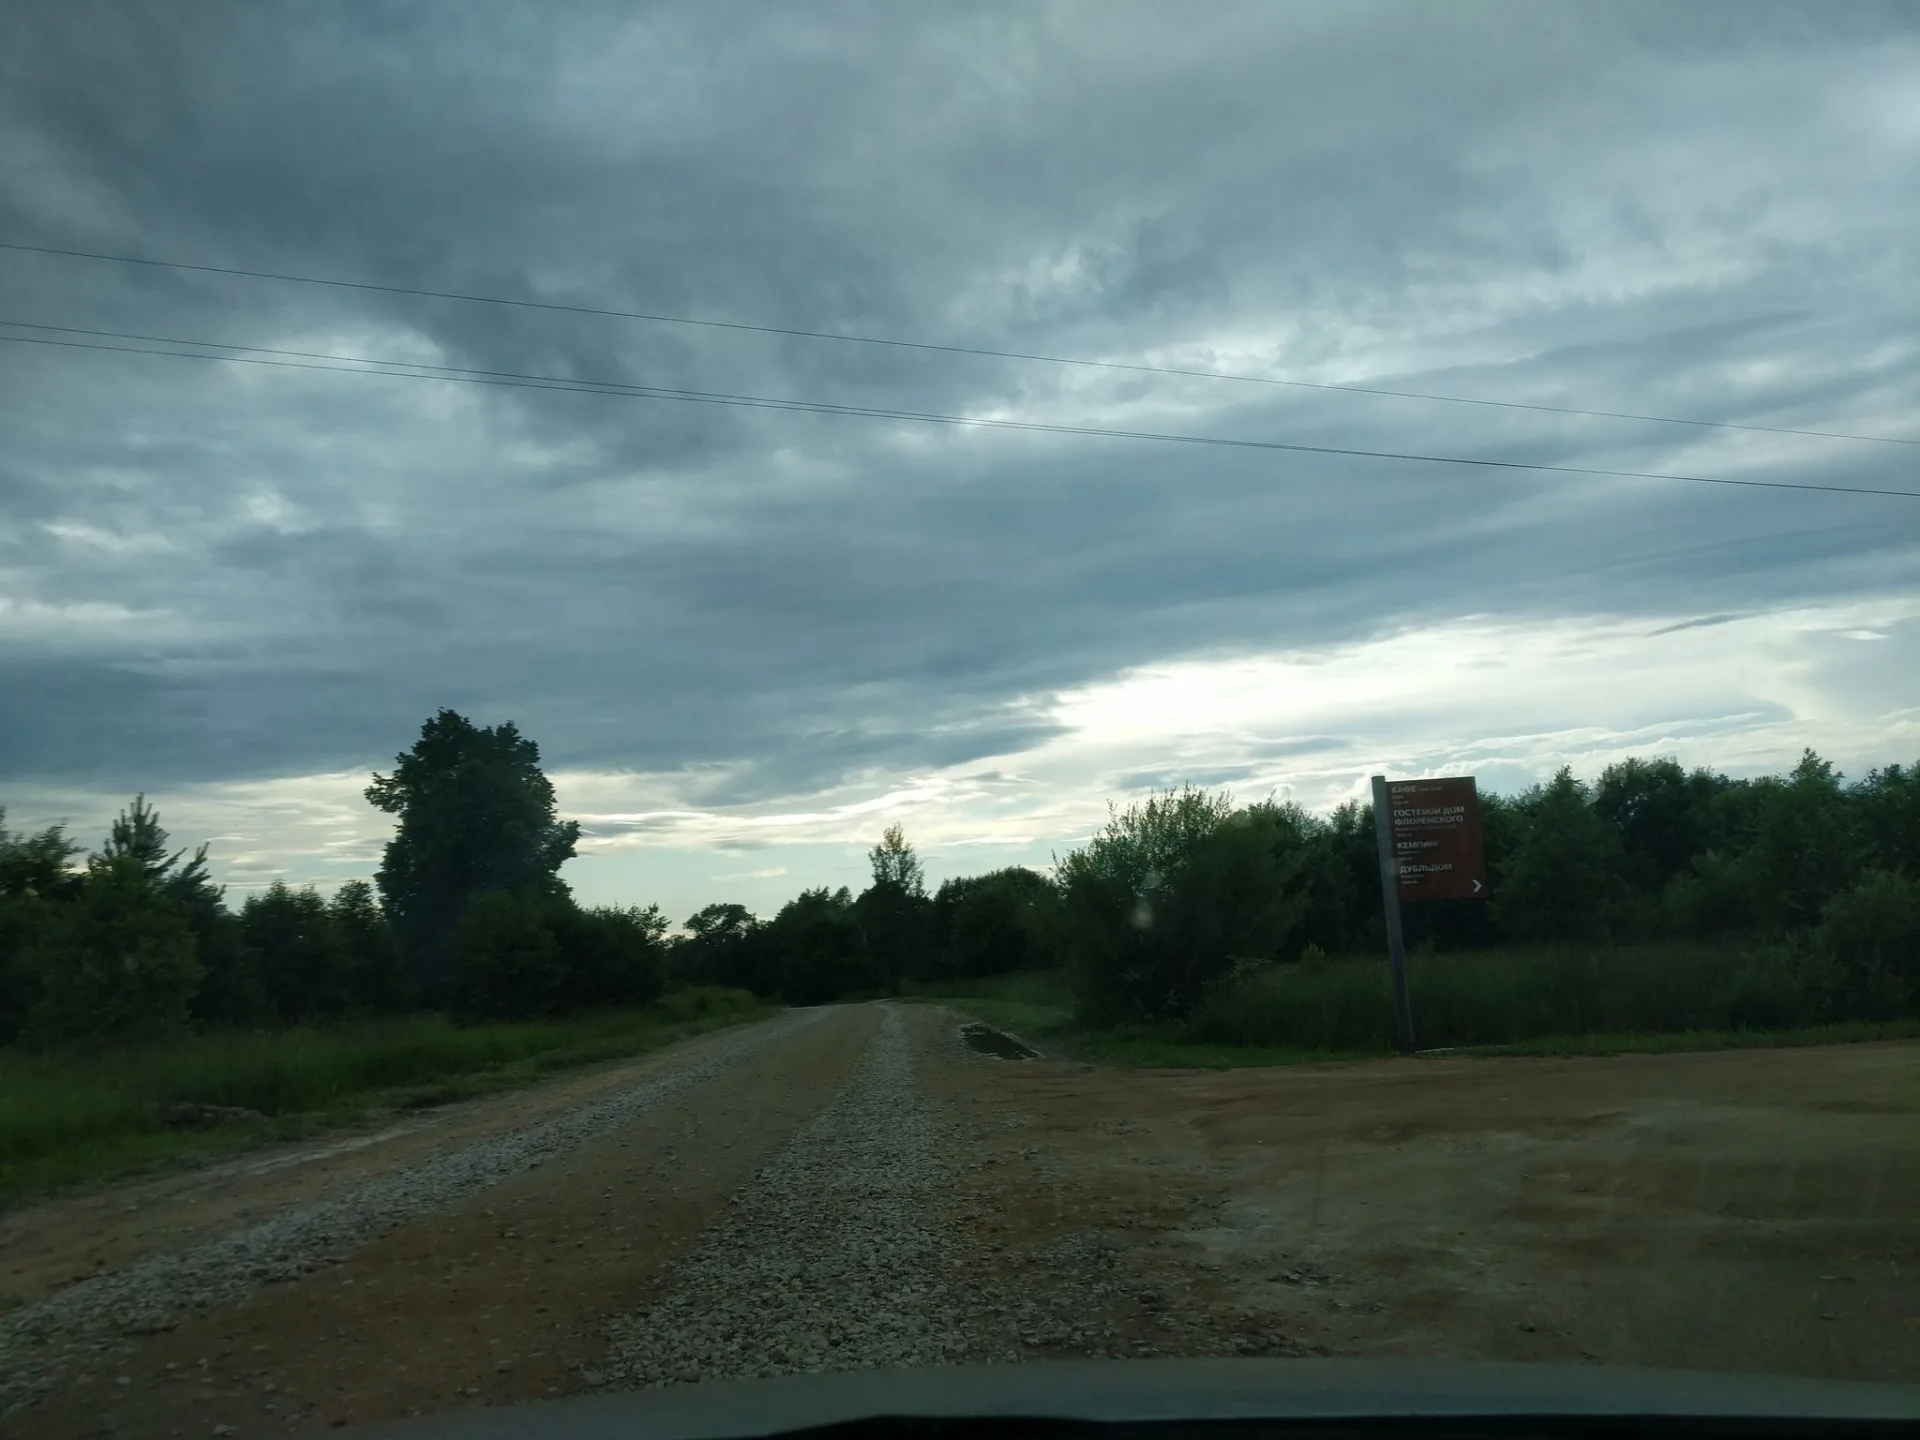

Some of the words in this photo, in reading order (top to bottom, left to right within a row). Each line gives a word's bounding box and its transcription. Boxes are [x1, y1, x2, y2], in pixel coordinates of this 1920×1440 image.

[1391, 785, 1417, 793] КАФЕ
[1443, 806, 1465, 815] ДОМ
[1394, 815, 1463, 825] ФЛОРЕНСКОГО
[1397, 840, 1439, 849] КЕМПИНГ
[1399, 864, 1452, 874] ДУБЛЬДОМ
